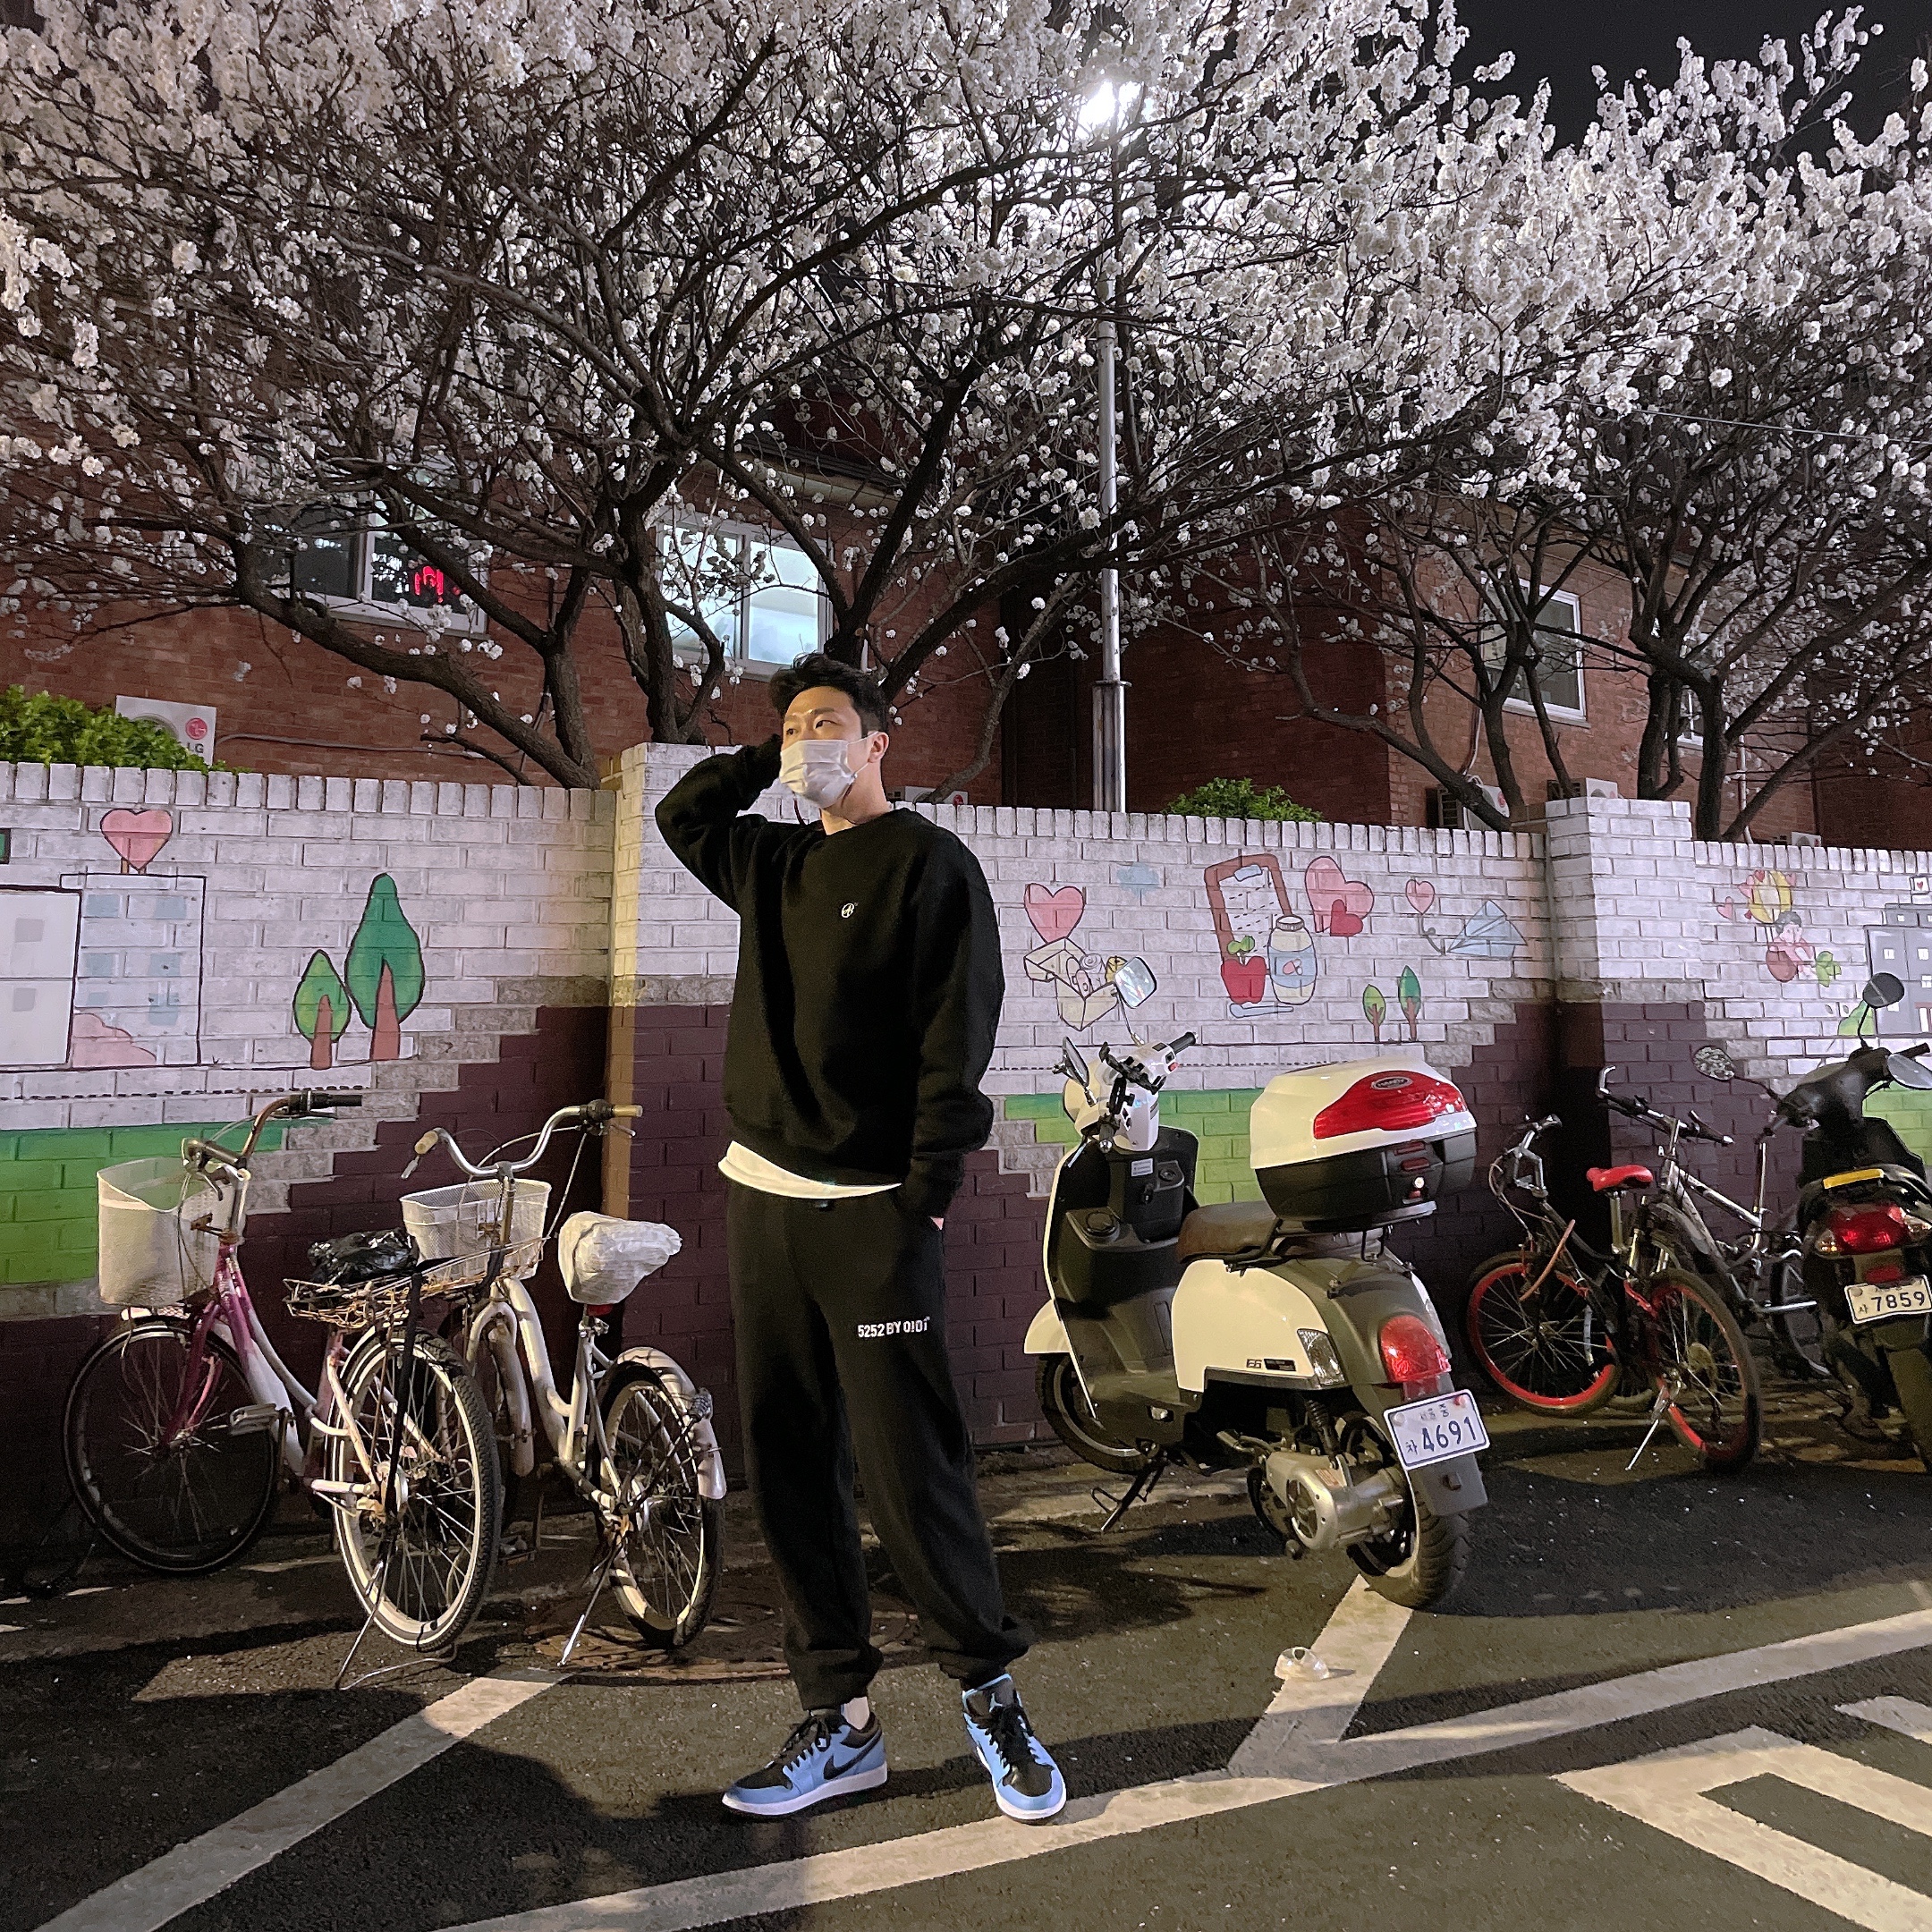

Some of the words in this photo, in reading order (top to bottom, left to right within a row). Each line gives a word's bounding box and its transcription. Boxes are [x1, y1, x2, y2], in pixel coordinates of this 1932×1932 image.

[186, 742, 204, 753] LG
[1870, 1291, 1925, 1312] 7859
[857, 1323, 886, 1338] 5252
[886, 1320, 902, 1335] BY
[1405, 1439, 1419, 1454] 차
[1420, 1416, 1477, 1453] 4691
